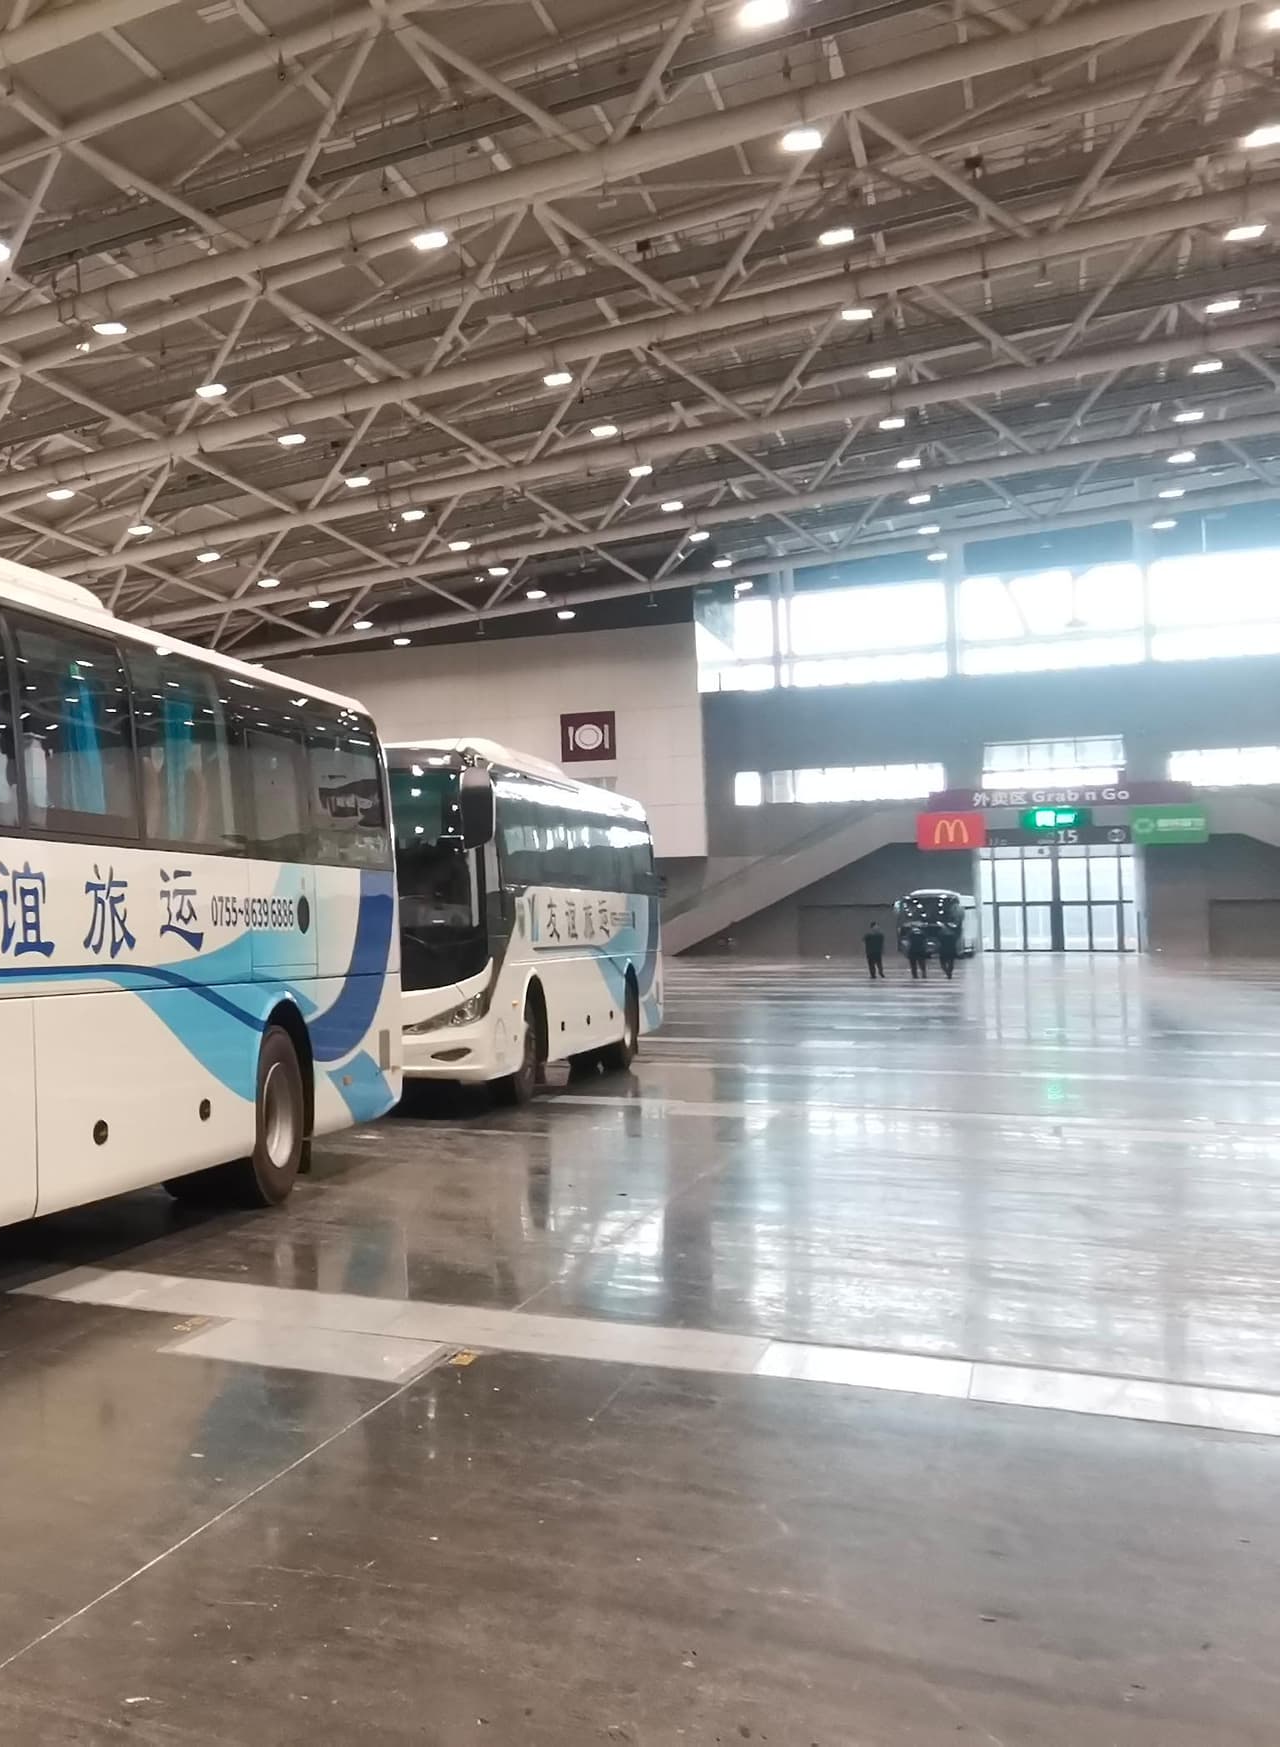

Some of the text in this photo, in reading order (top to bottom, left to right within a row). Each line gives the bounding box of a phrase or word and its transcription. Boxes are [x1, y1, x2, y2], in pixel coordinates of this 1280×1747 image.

[972, 791, 1028, 807] 外卖区
[1101, 788, 1130, 800] Go
[1057, 830, 1078, 844] 15
